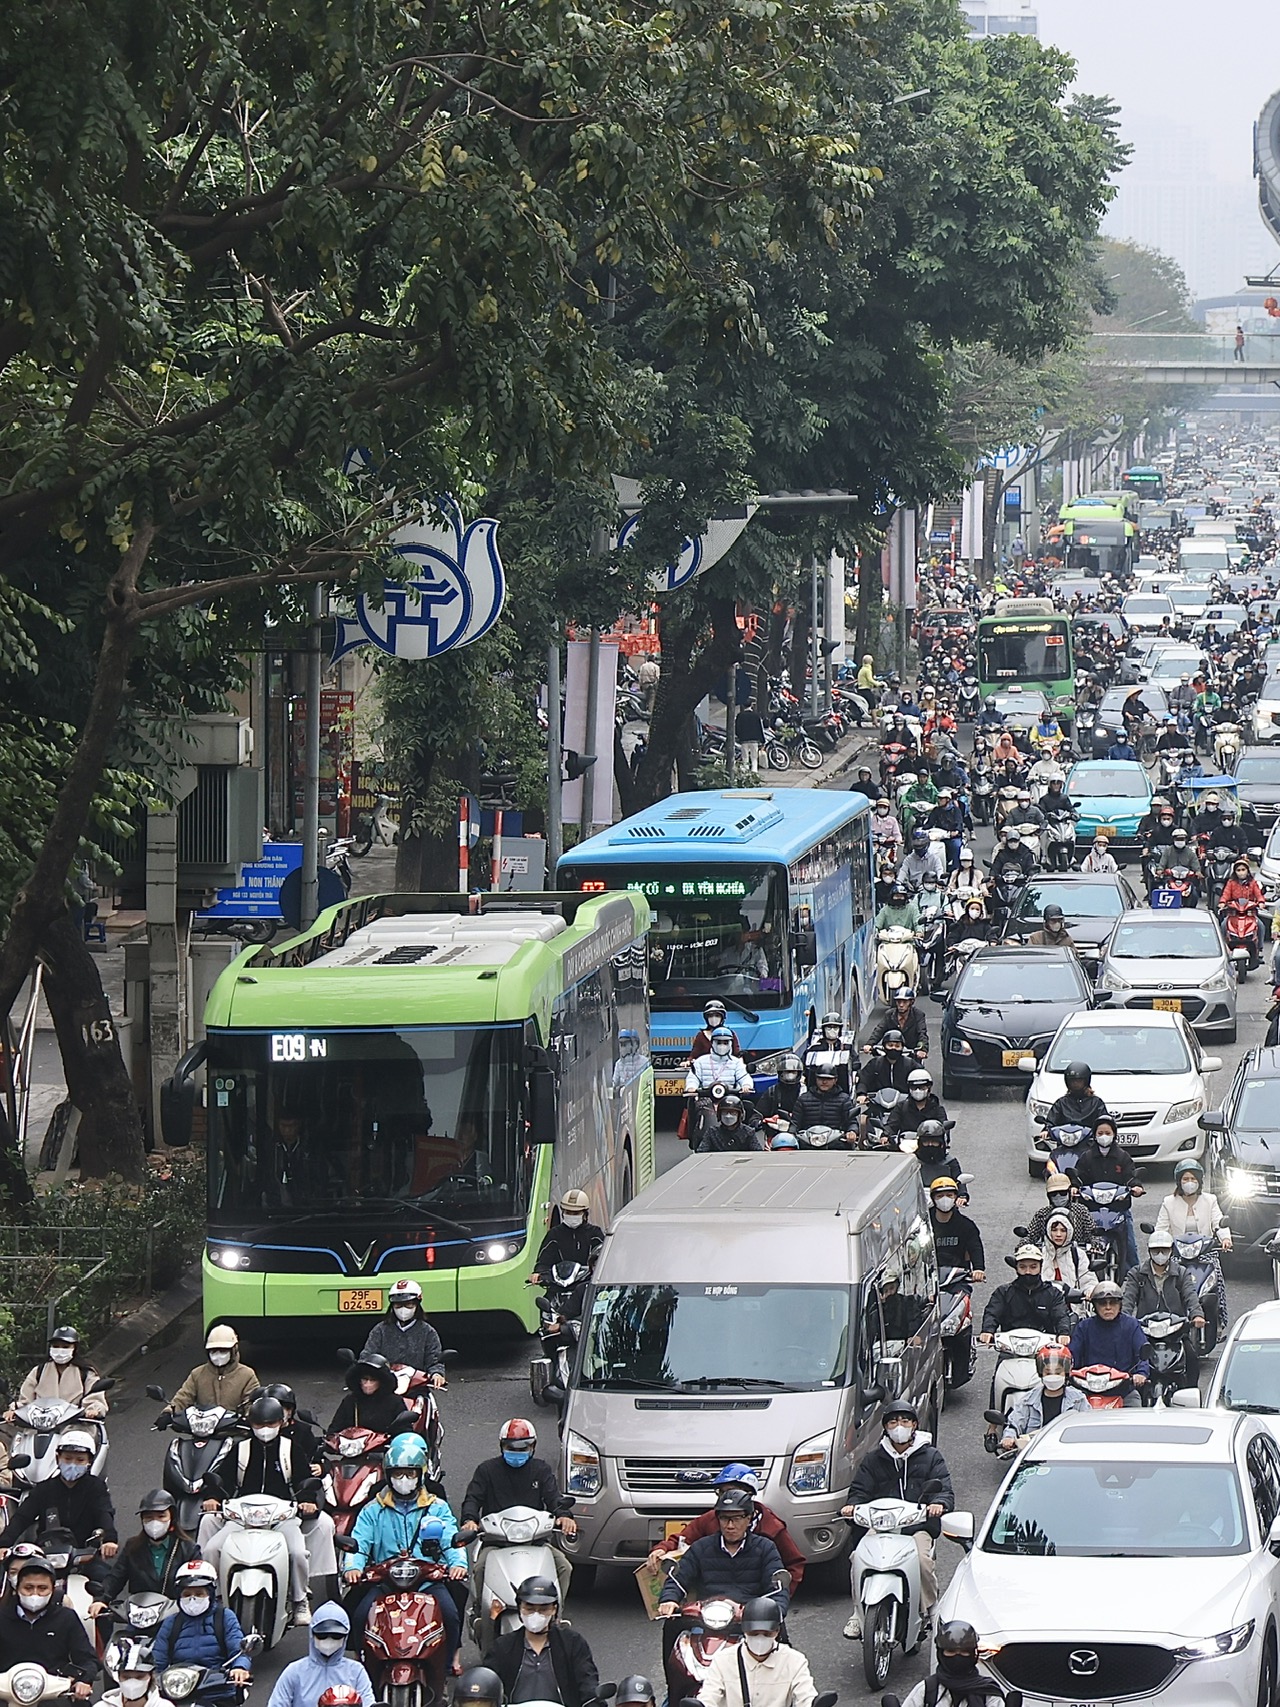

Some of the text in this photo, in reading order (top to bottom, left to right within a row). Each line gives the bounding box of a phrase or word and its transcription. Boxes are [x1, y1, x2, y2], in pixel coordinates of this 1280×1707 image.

[1158, 891, 1175, 907] G7
[82, 1019, 114, 1045] 163
[271, 1033, 306, 1061] E09
[664, 1079, 678, 1087] 29F
[351, 1290, 370, 1300] 29F
[343, 1300, 378, 1310] 024.59
[682, 1470, 703, 1480] Ford
